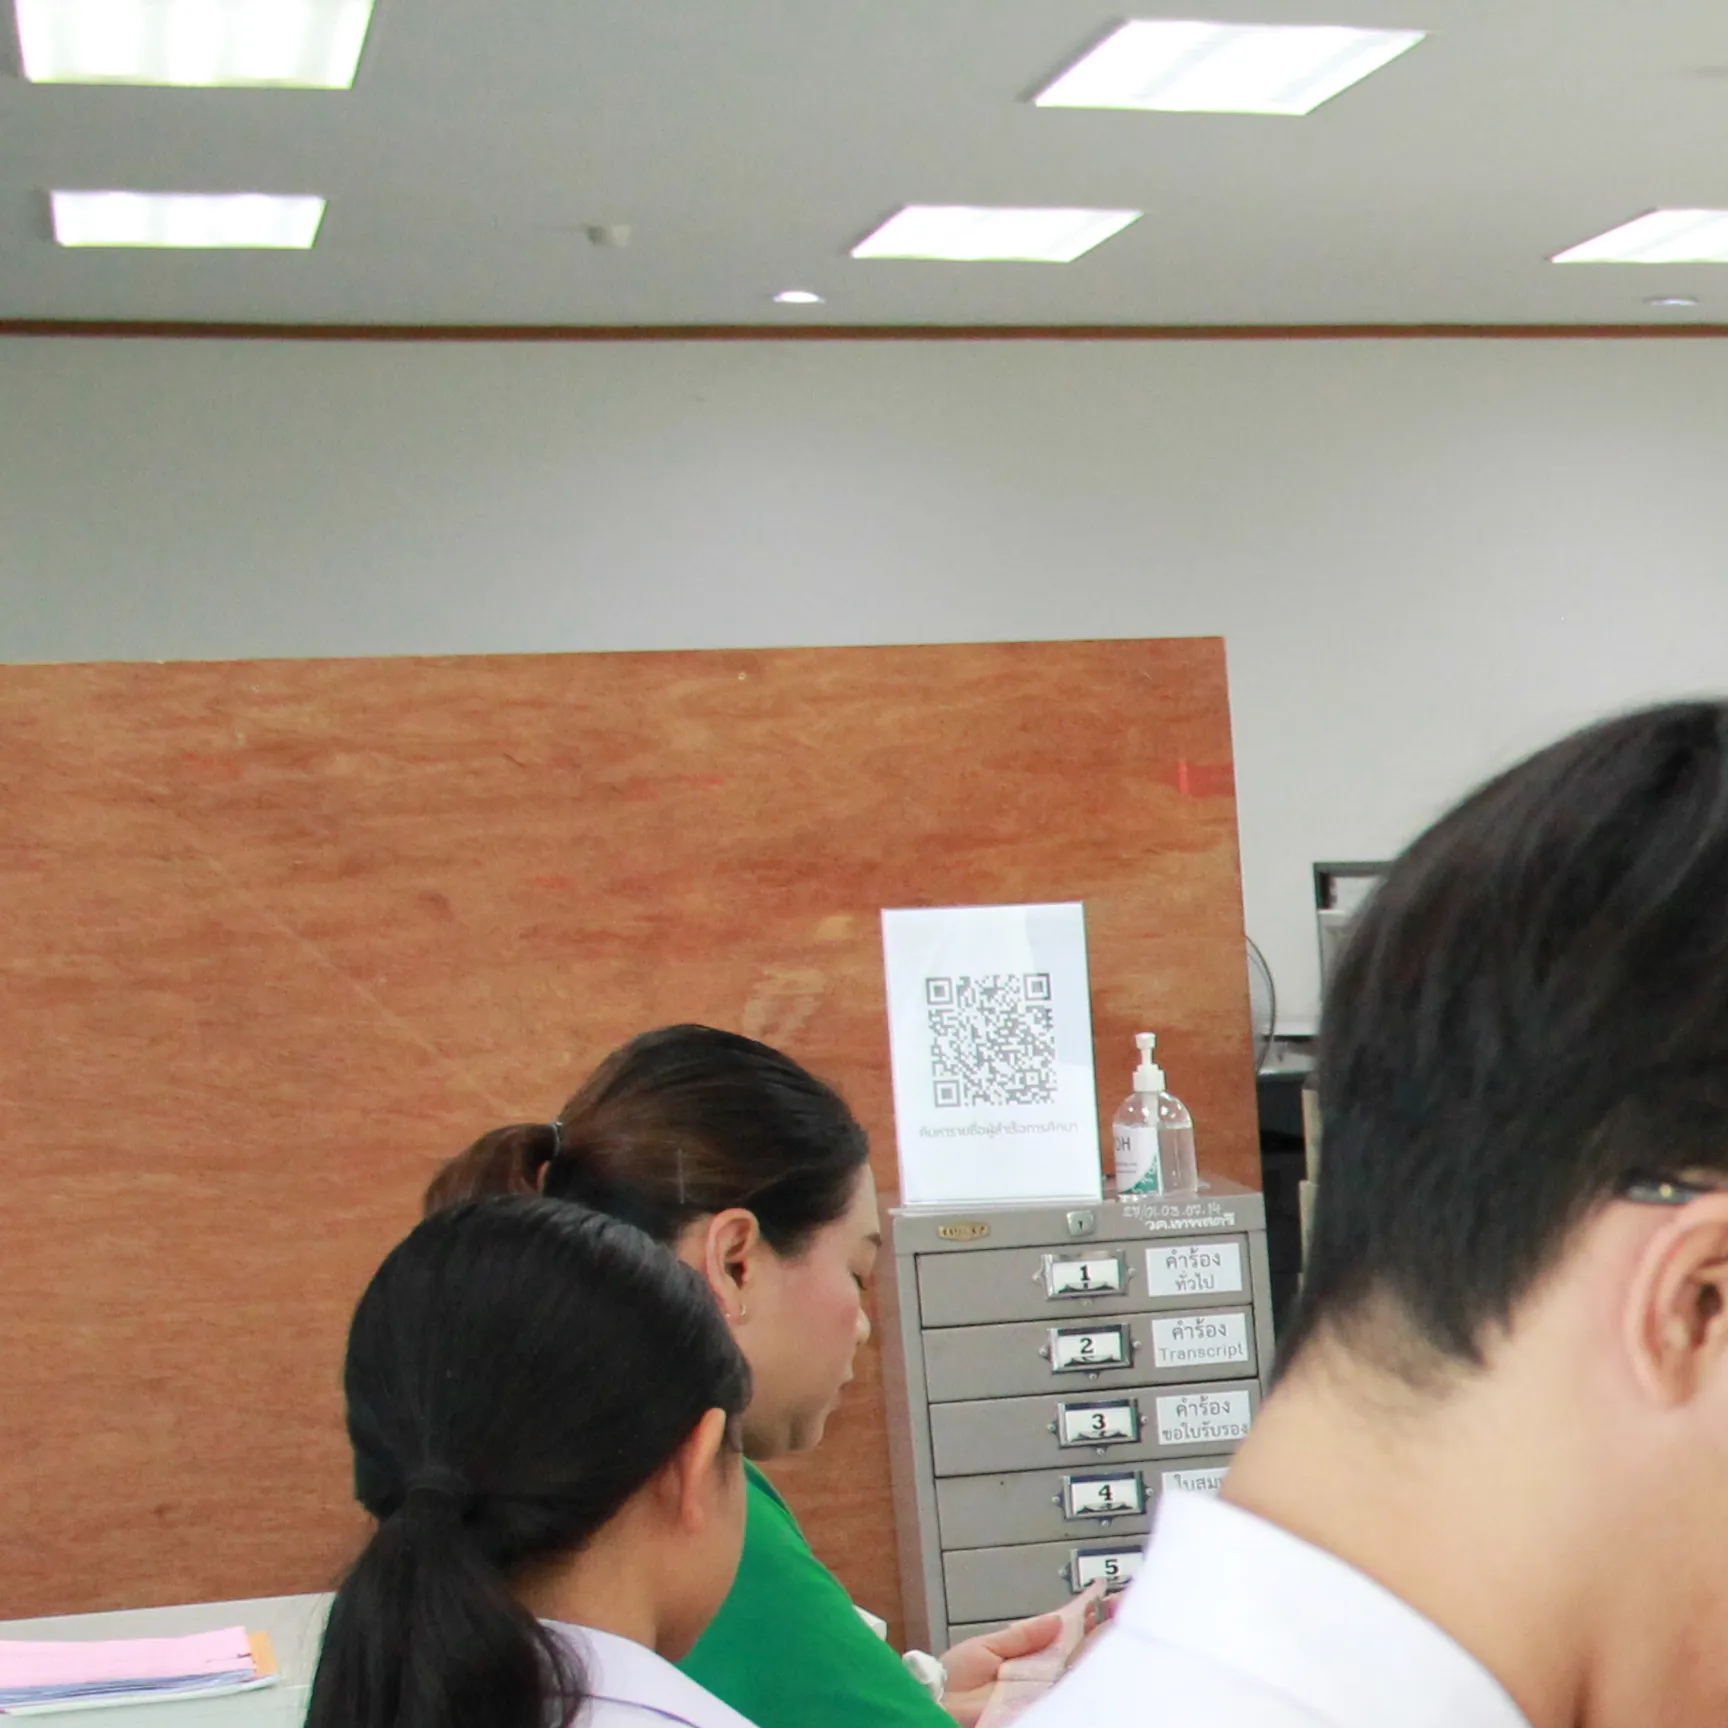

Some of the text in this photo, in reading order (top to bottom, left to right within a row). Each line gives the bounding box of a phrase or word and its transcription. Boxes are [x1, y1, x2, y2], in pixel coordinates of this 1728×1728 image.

[1165, 1247, 1222, 1270] คำร้อง
[1079, 1264, 1091, 1282] 1
[1175, 1270, 1215, 1292] ทั่วไป
[1172, 1318, 1228, 1341] คำร้อง
[1080, 1337, 1093, 1354] 2
[1158, 1341, 1244, 1362] Transcript
[1176, 1395, 1231, 1418] คำร้อง
[1092, 1413, 1105, 1430] 3
[1162, 1419, 1249, 1442] ขอใบรับรอง
[1173, 1473, 1224, 1491] ใบสม
[1098, 1483, 1112, 1501] 4
[1105, 1558, 1119, 1575] 5
